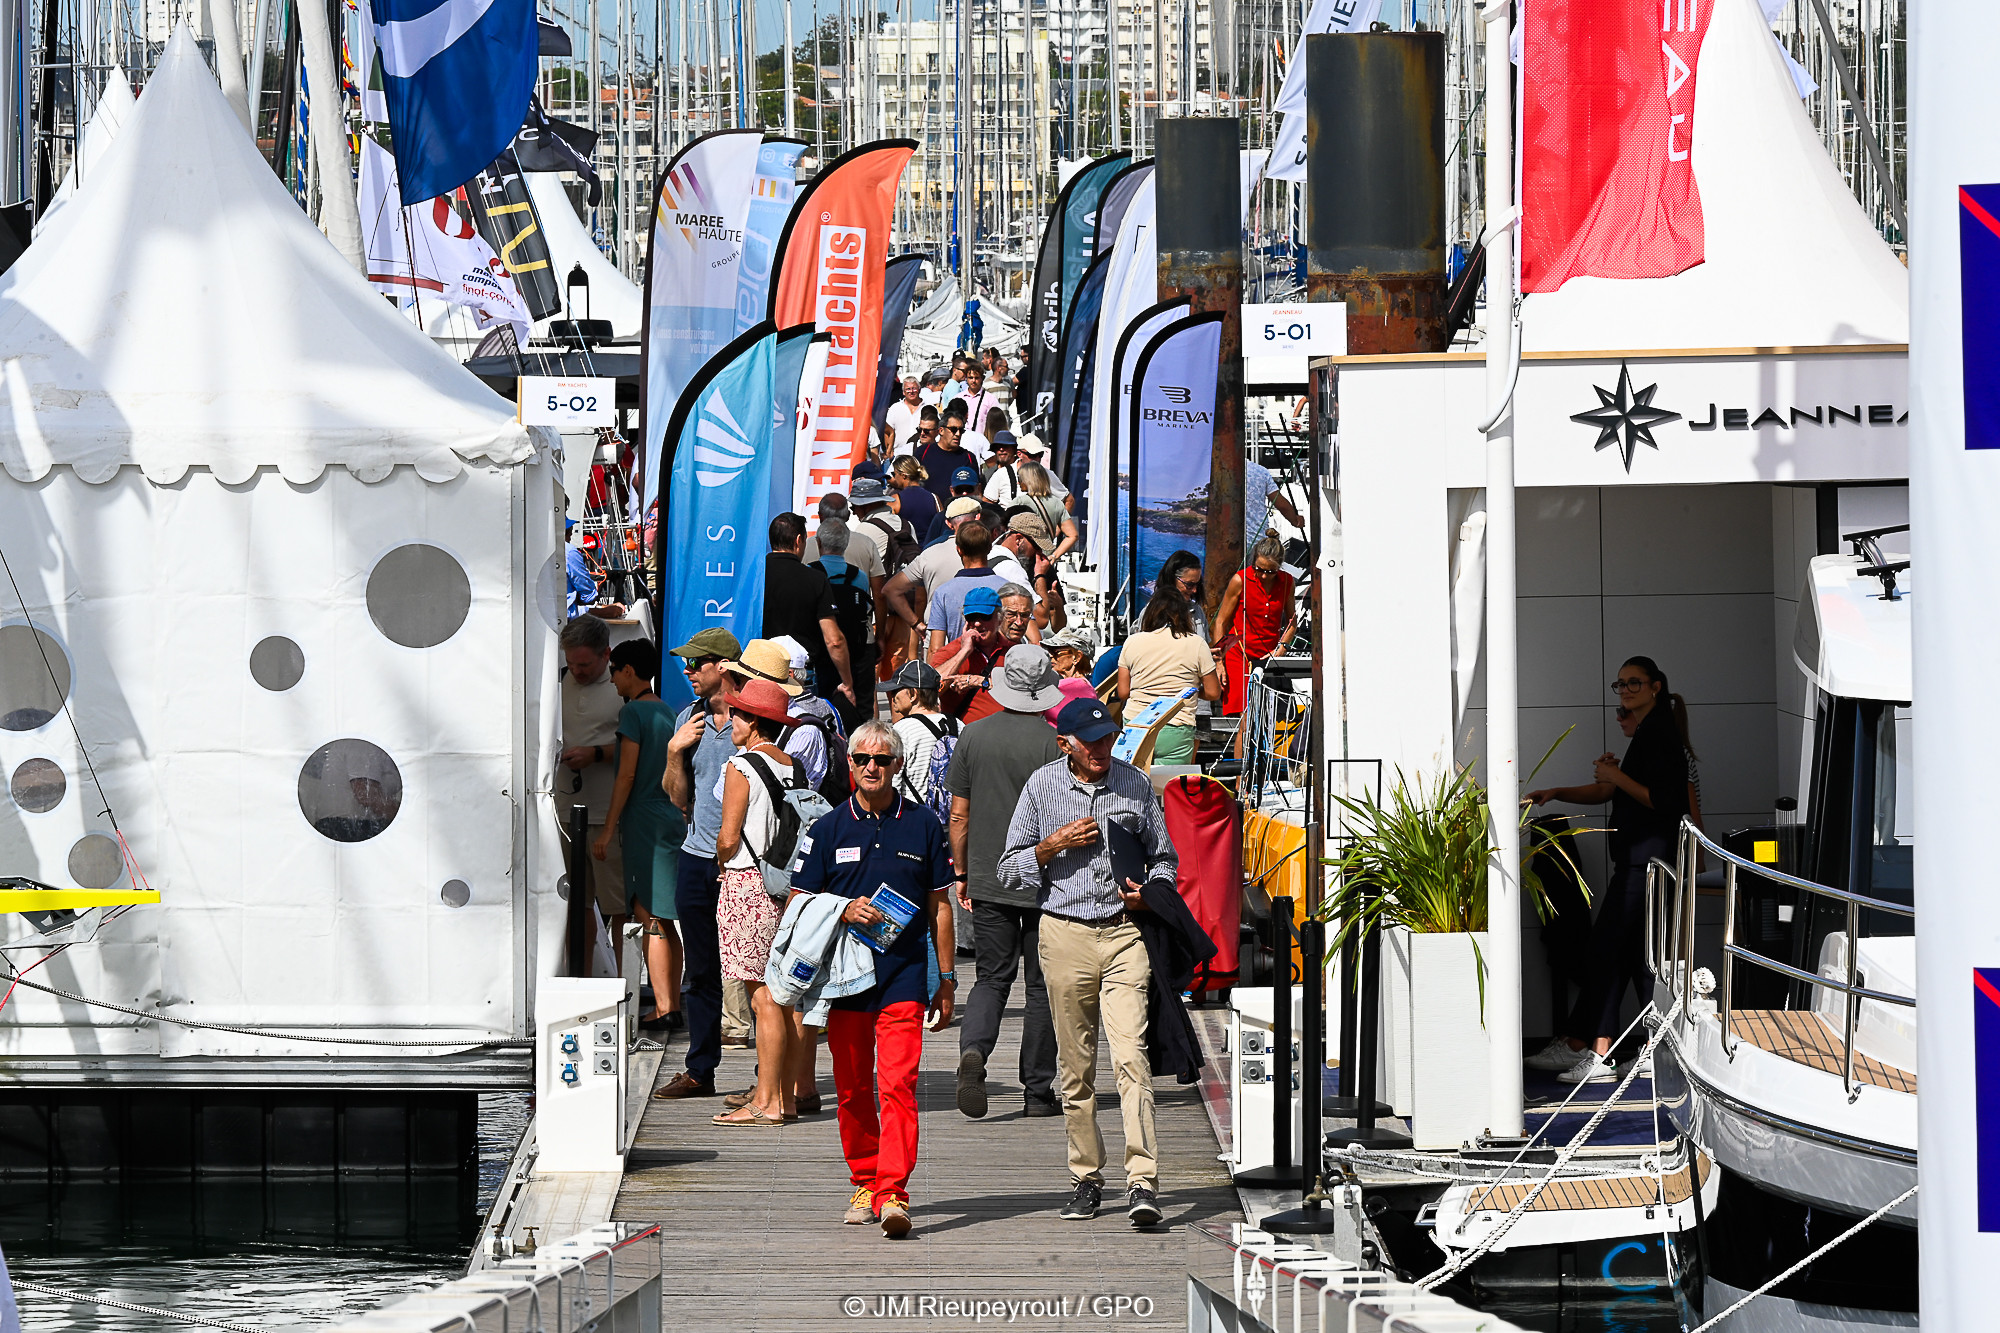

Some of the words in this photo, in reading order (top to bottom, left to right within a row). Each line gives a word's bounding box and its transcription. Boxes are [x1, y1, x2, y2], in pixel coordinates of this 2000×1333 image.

[675, 213, 724, 228] MAREE
[698, 228, 742, 243] HAUTE
[711, 250, 741, 269] GROUPE
[1264, 323, 1311, 340] 5-01
[547, 395, 597, 411] 5-02
[1143, 408, 1210, 424] BREVA
